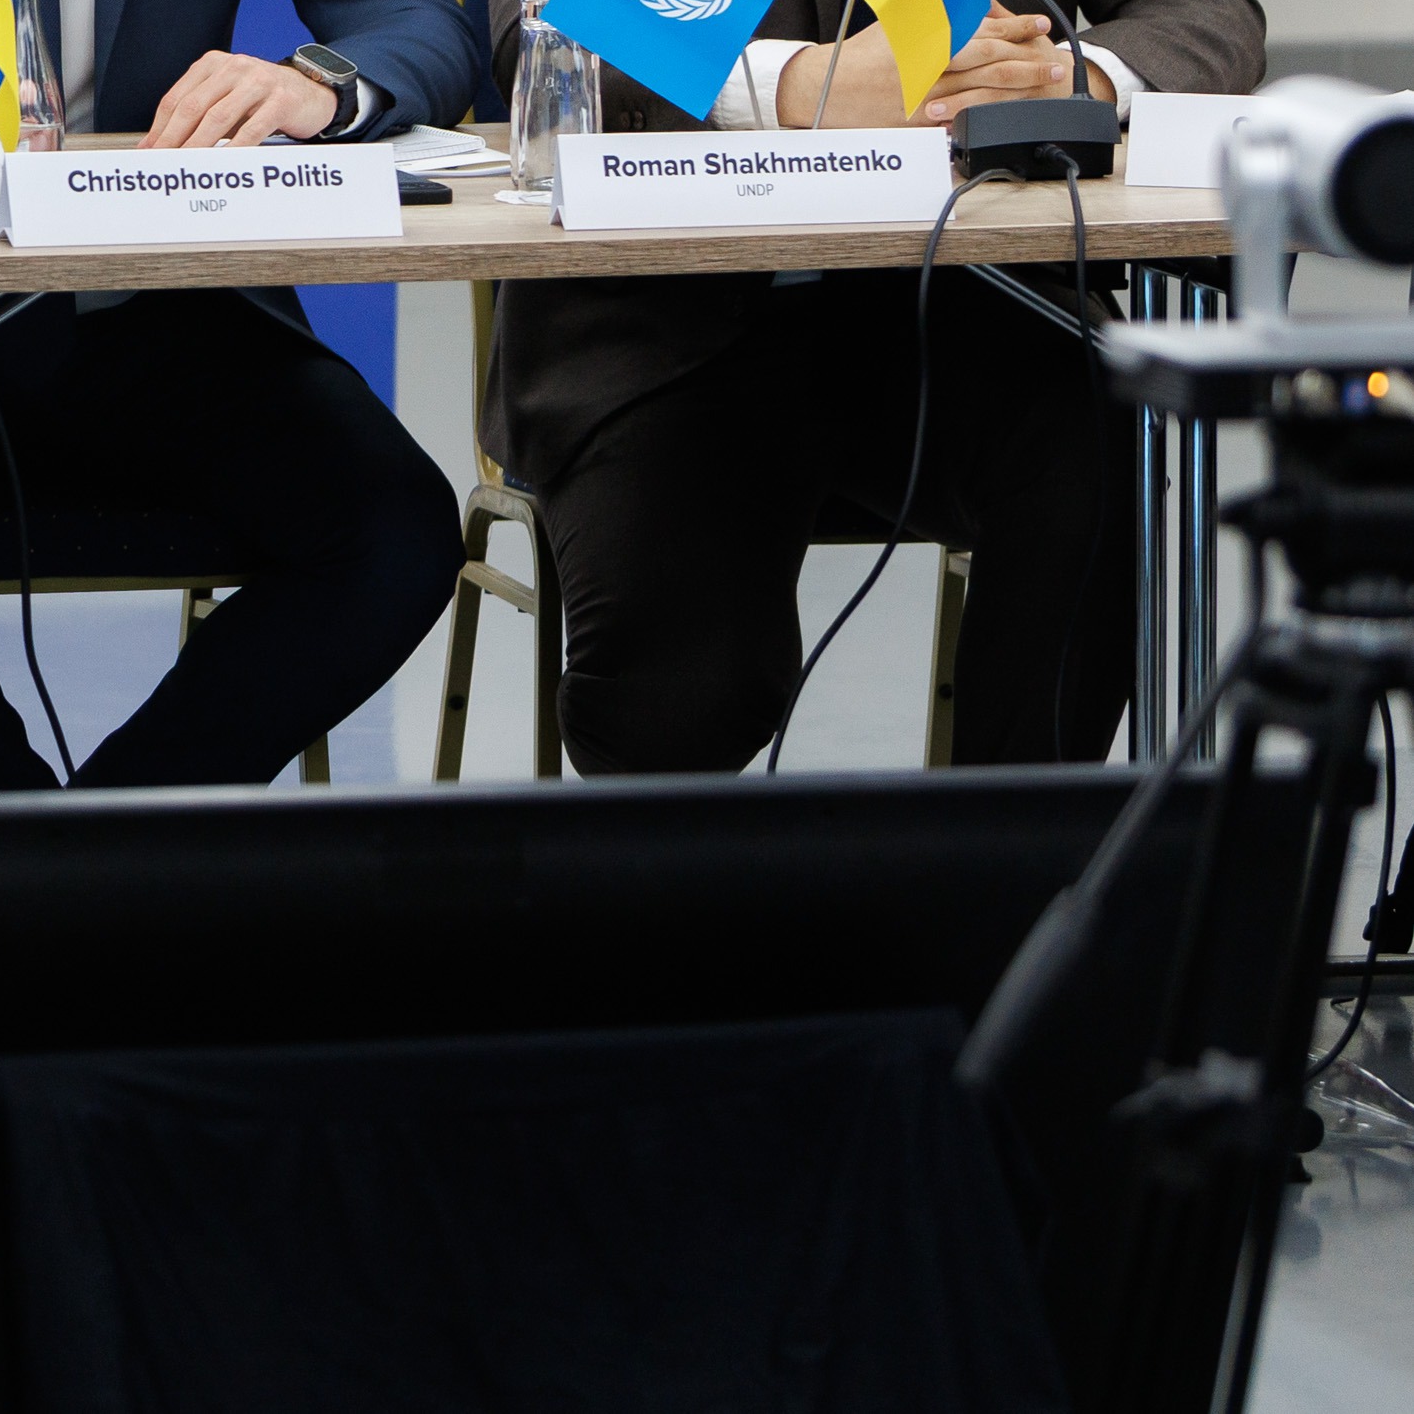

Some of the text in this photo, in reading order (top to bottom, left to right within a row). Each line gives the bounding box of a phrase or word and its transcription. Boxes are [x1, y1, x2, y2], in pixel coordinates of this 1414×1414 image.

[603, 150, 903, 179] Roman Shakhmatenko
[68, 164, 345, 197] Christophoros Politis
[737, 183, 776, 199] UNDP
[189, 199, 229, 214] UNDP
